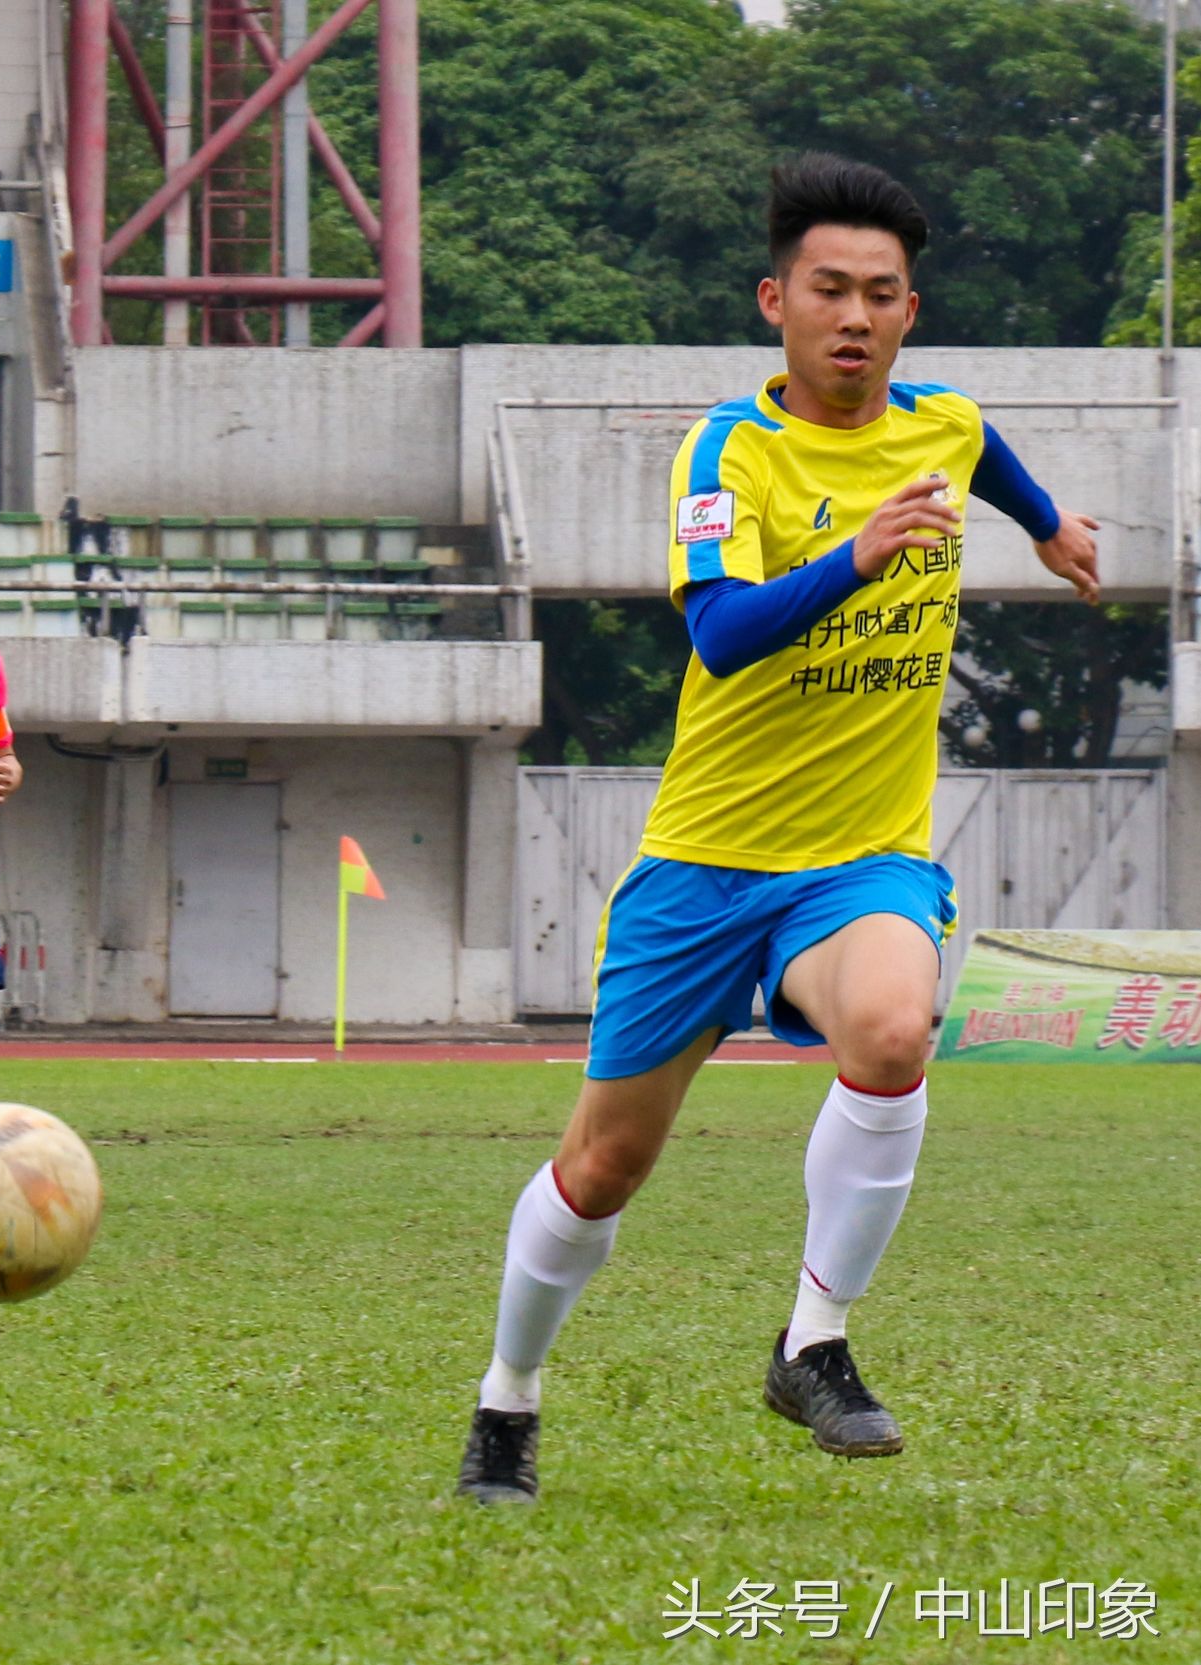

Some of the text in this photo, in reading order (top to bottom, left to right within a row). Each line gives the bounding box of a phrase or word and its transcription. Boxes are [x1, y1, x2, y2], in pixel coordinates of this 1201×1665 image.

[790, 652, 943, 696] 中山樱花里
